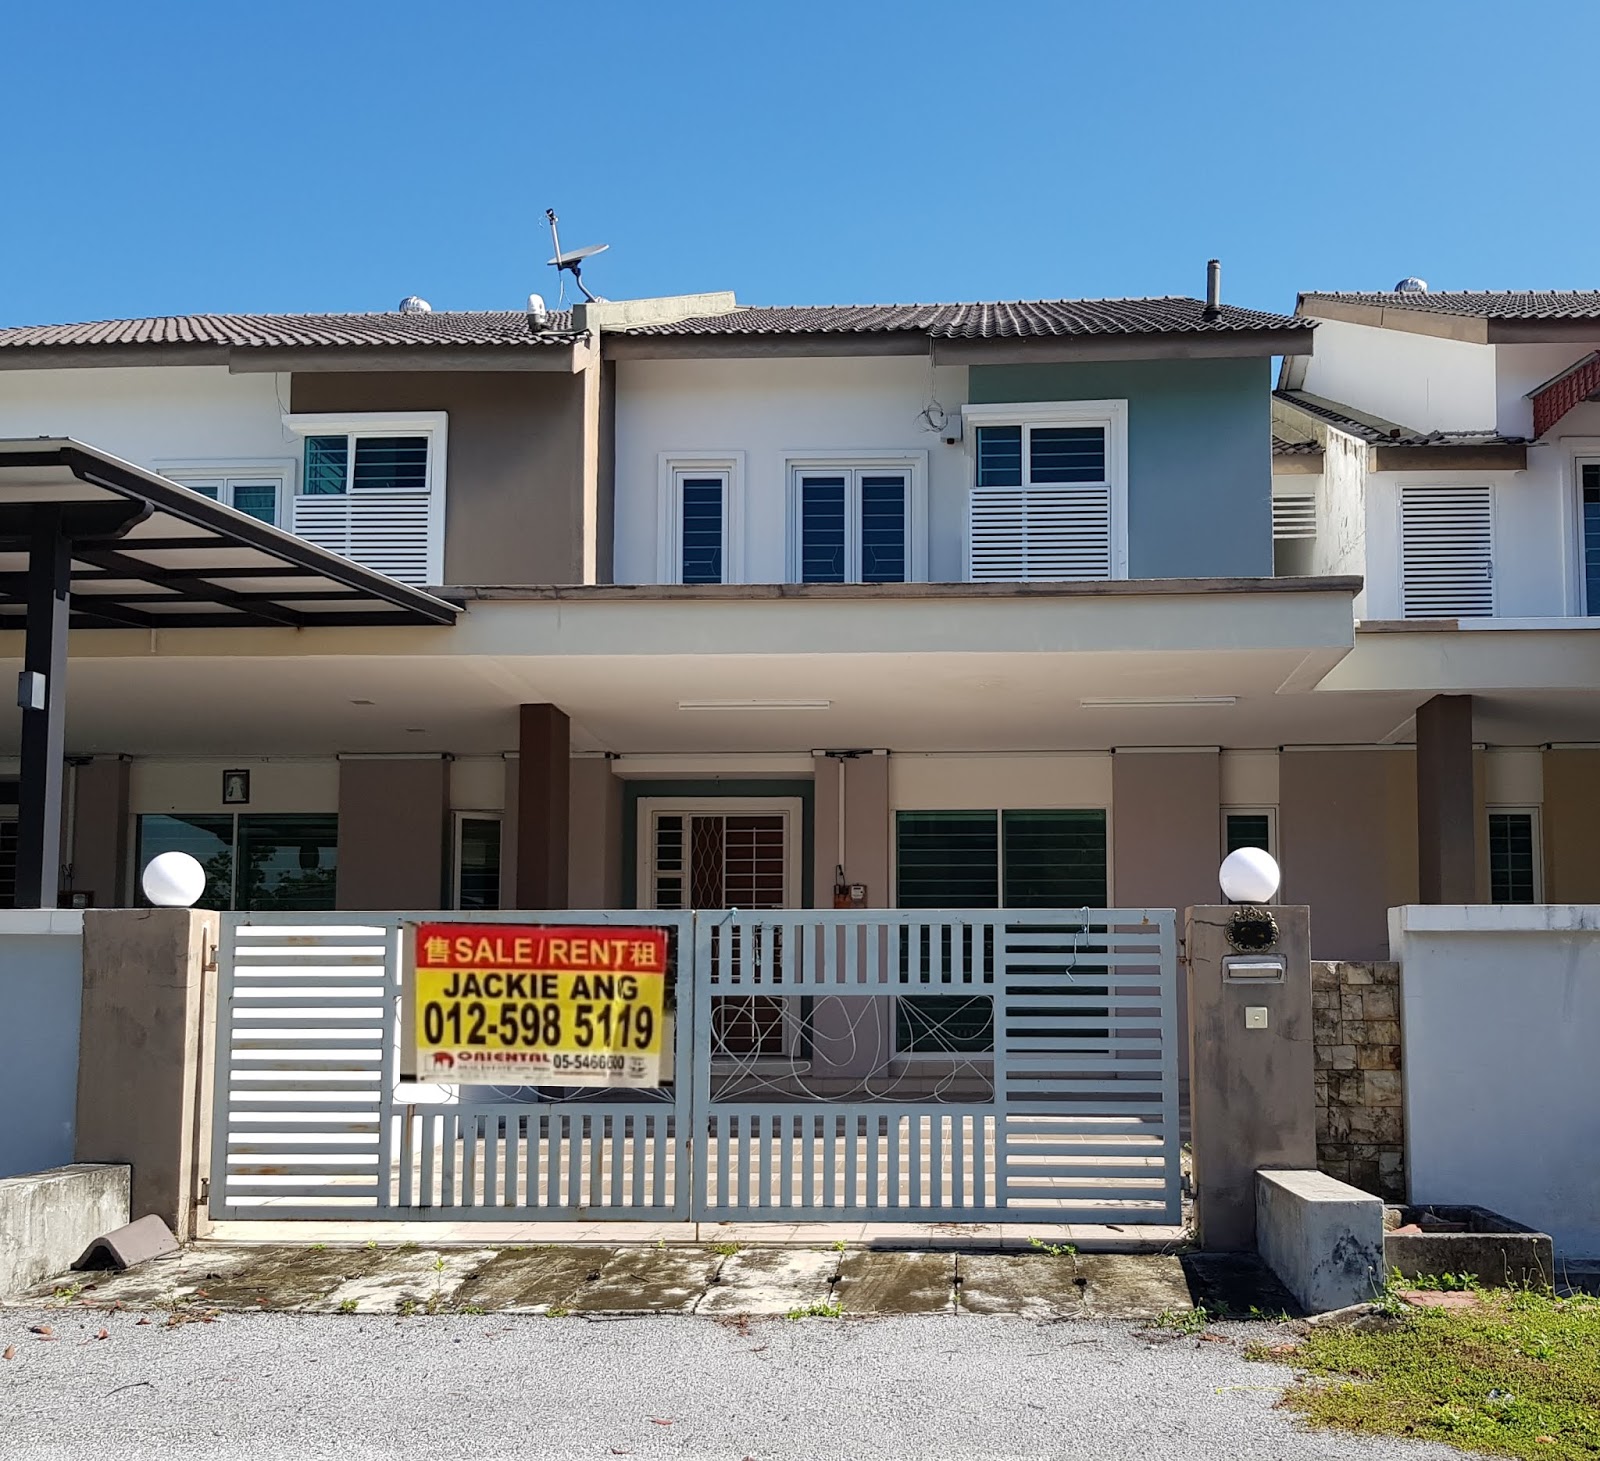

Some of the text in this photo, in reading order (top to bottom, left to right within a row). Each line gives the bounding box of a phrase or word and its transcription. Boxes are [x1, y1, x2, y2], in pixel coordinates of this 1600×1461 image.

[425, 936, 450, 963] 售
[630, 940, 657, 967] 租
[443, 973, 638, 1000] JACKIE ANG
[424, 1001, 653, 1049] 012-598 5119
